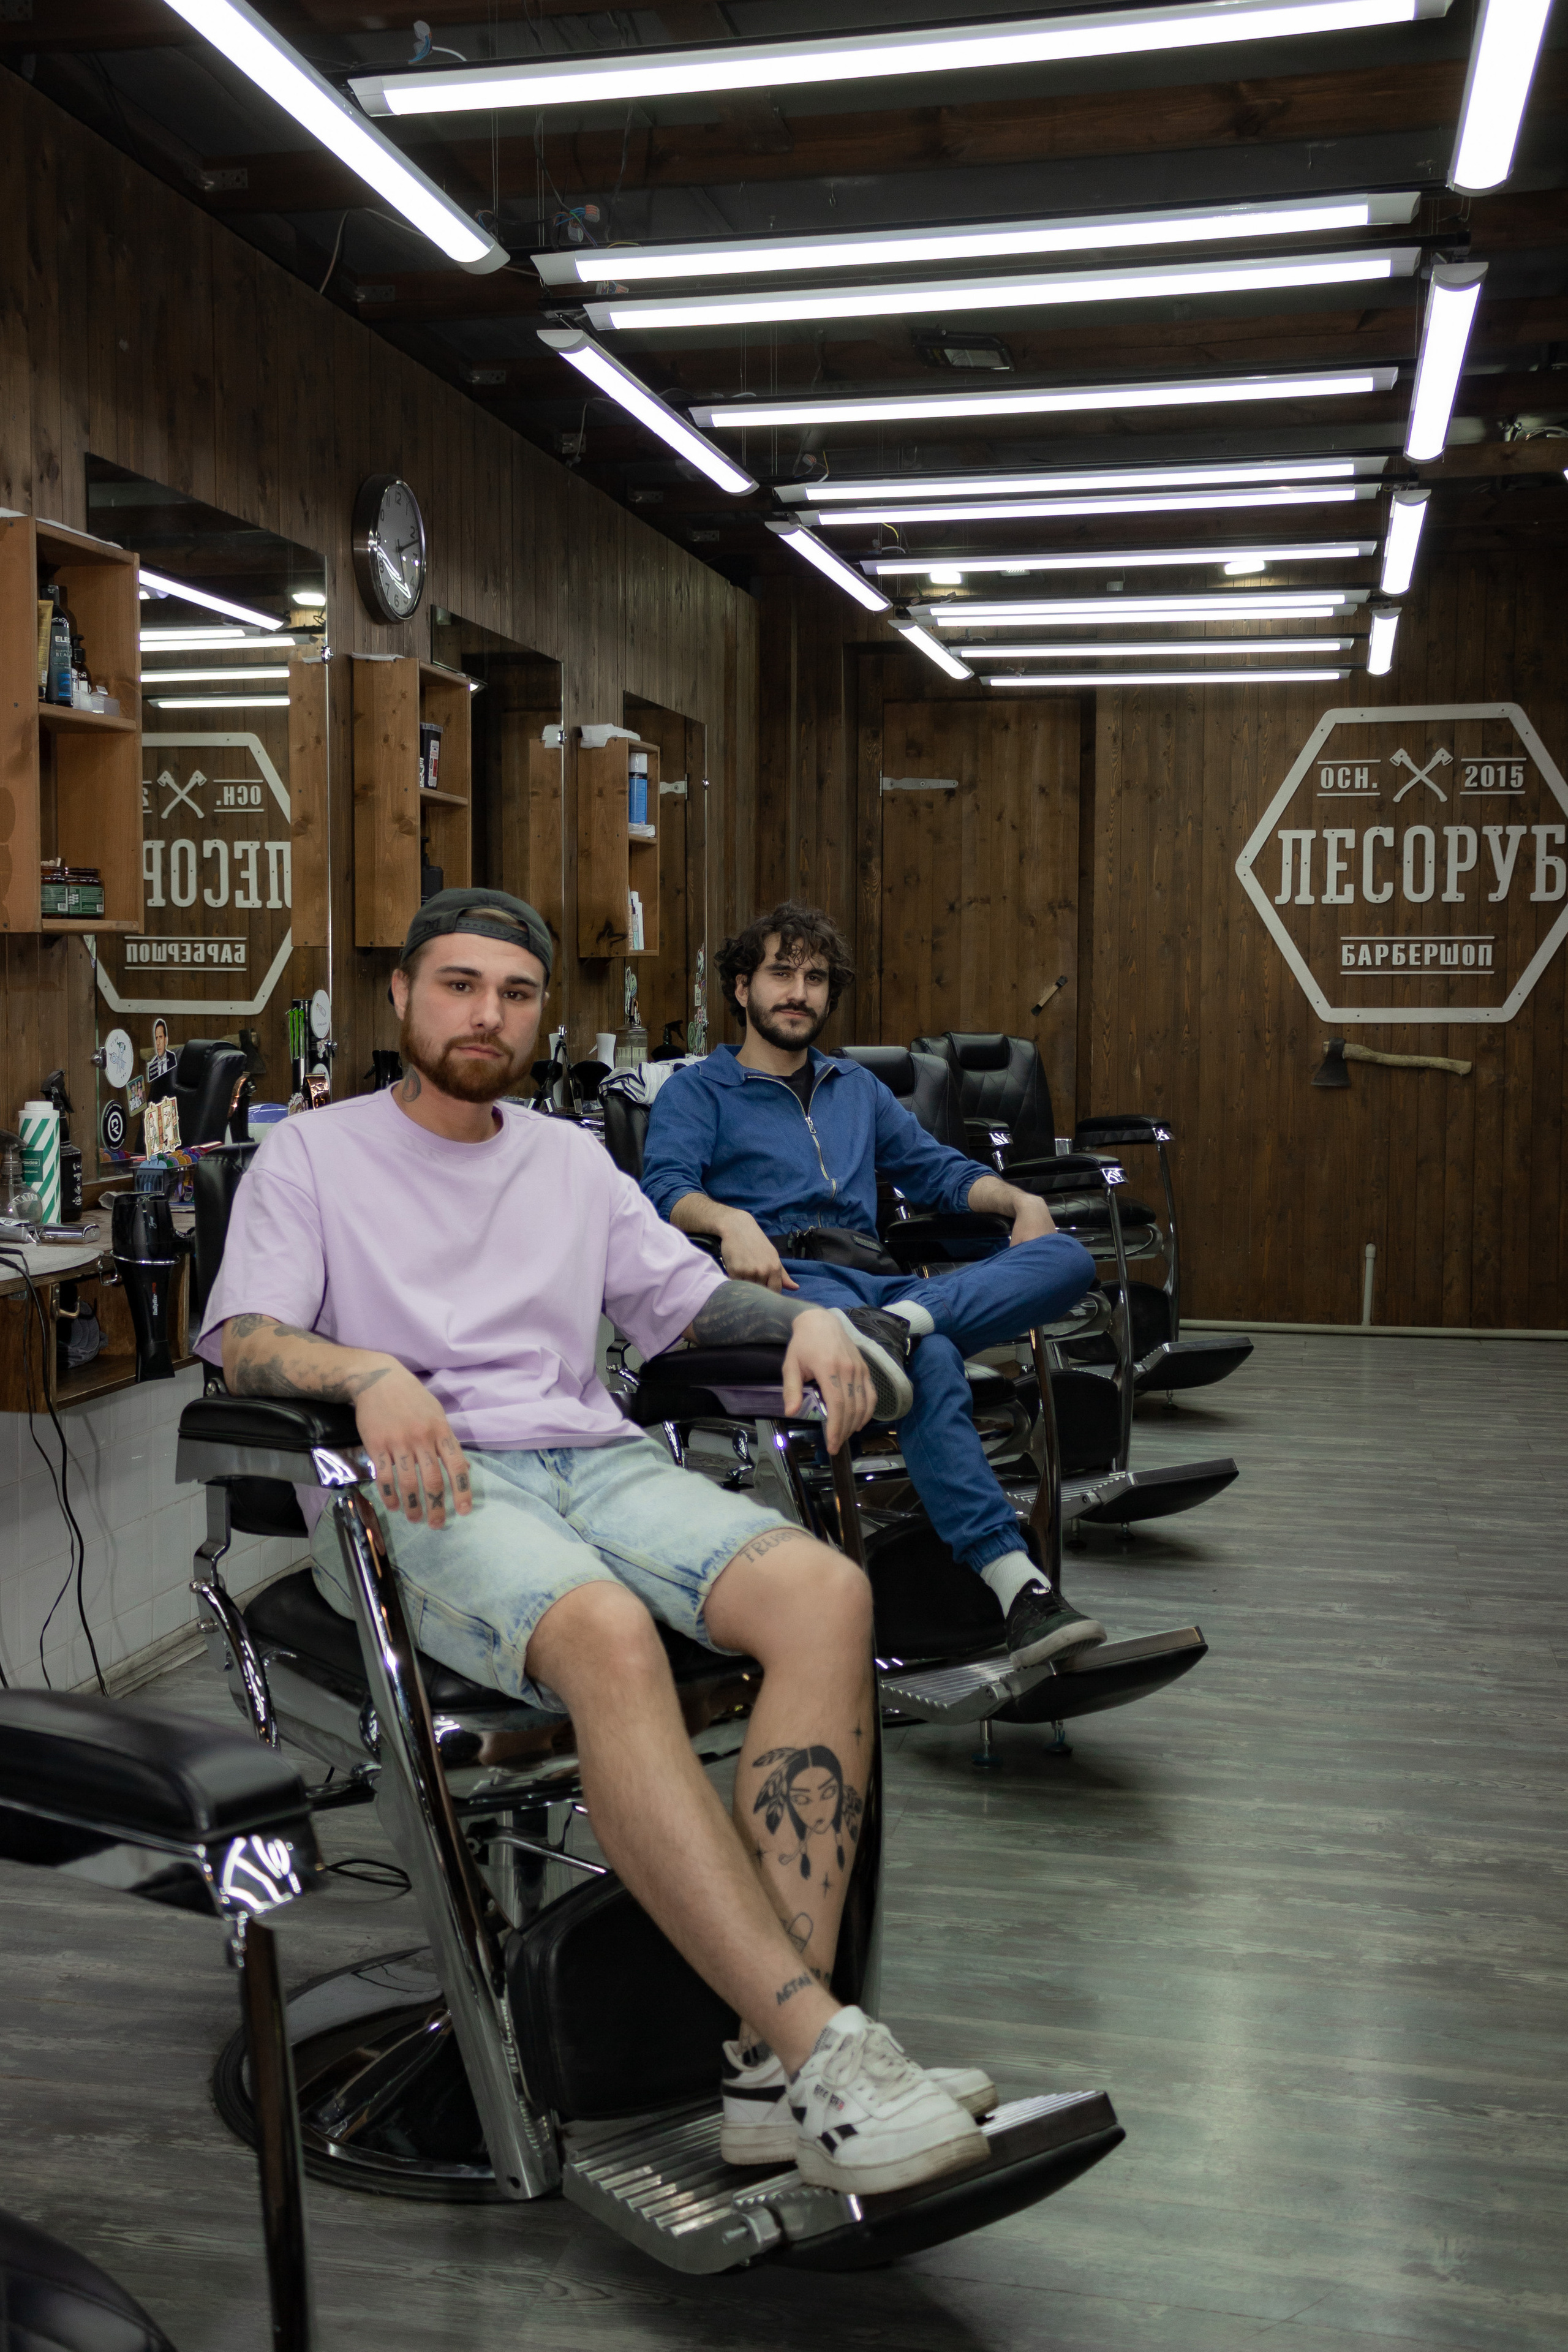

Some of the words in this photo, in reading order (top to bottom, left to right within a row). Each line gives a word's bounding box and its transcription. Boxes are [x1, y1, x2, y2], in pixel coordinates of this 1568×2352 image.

[386, 494, 391, 508] 11
[395, 490, 401, 505] 12
[377, 532, 381, 545] 9
[410, 526, 415, 539] 2
[379, 560, 385, 574] 8
[385, 582, 390, 597] 7
[410, 576, 415, 589] 4
[394, 594, 399, 608] 6
[1320, 766, 1378, 790] ОСН.
[1464, 765, 1524, 788] 2015
[1274, 824, 1567, 905] ЛЕСОРУБ
[1341, 943, 1493, 967] БАРБЕРШОП
